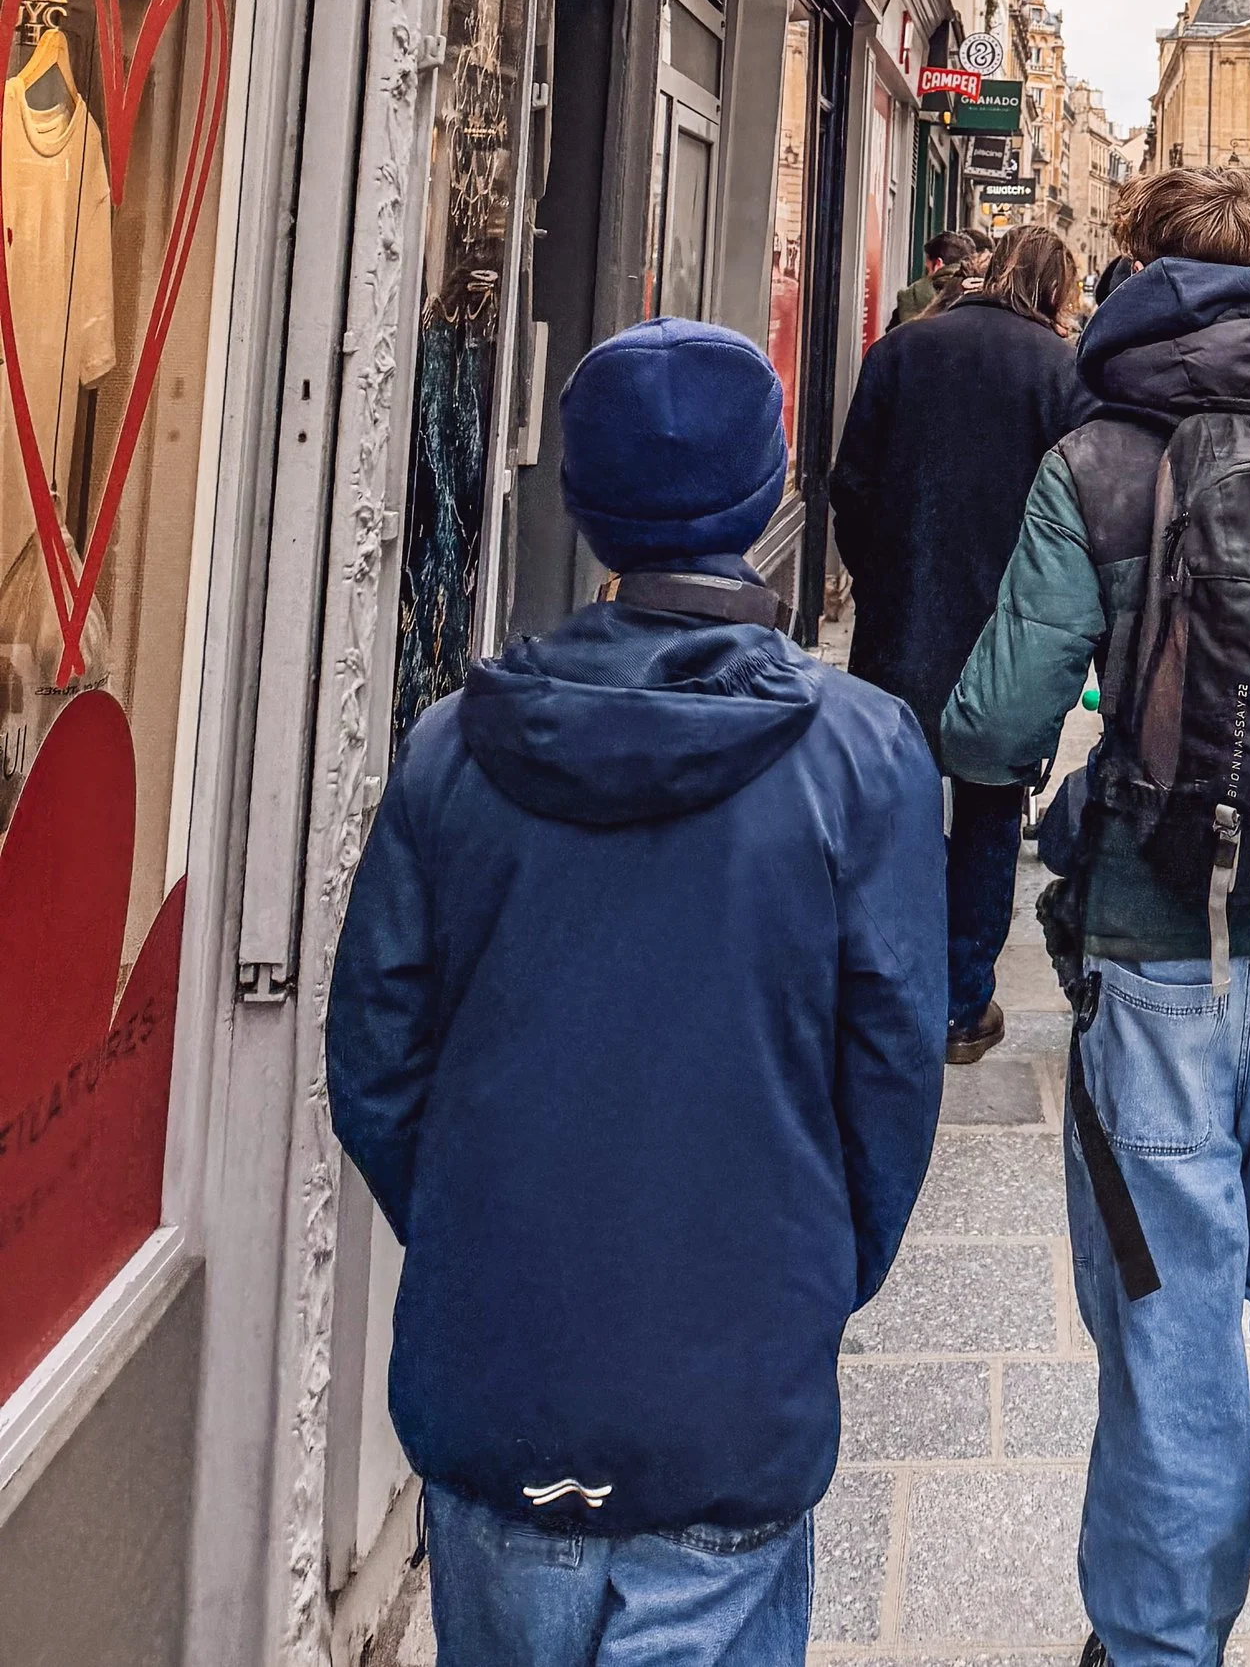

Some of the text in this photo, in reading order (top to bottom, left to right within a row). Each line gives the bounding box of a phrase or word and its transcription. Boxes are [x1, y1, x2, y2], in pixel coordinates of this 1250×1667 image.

[921, 71, 978, 97] CAMPER
[985, 185, 1025, 196] swatch
[1226, 698, 1249, 799] BIONNASSAY
